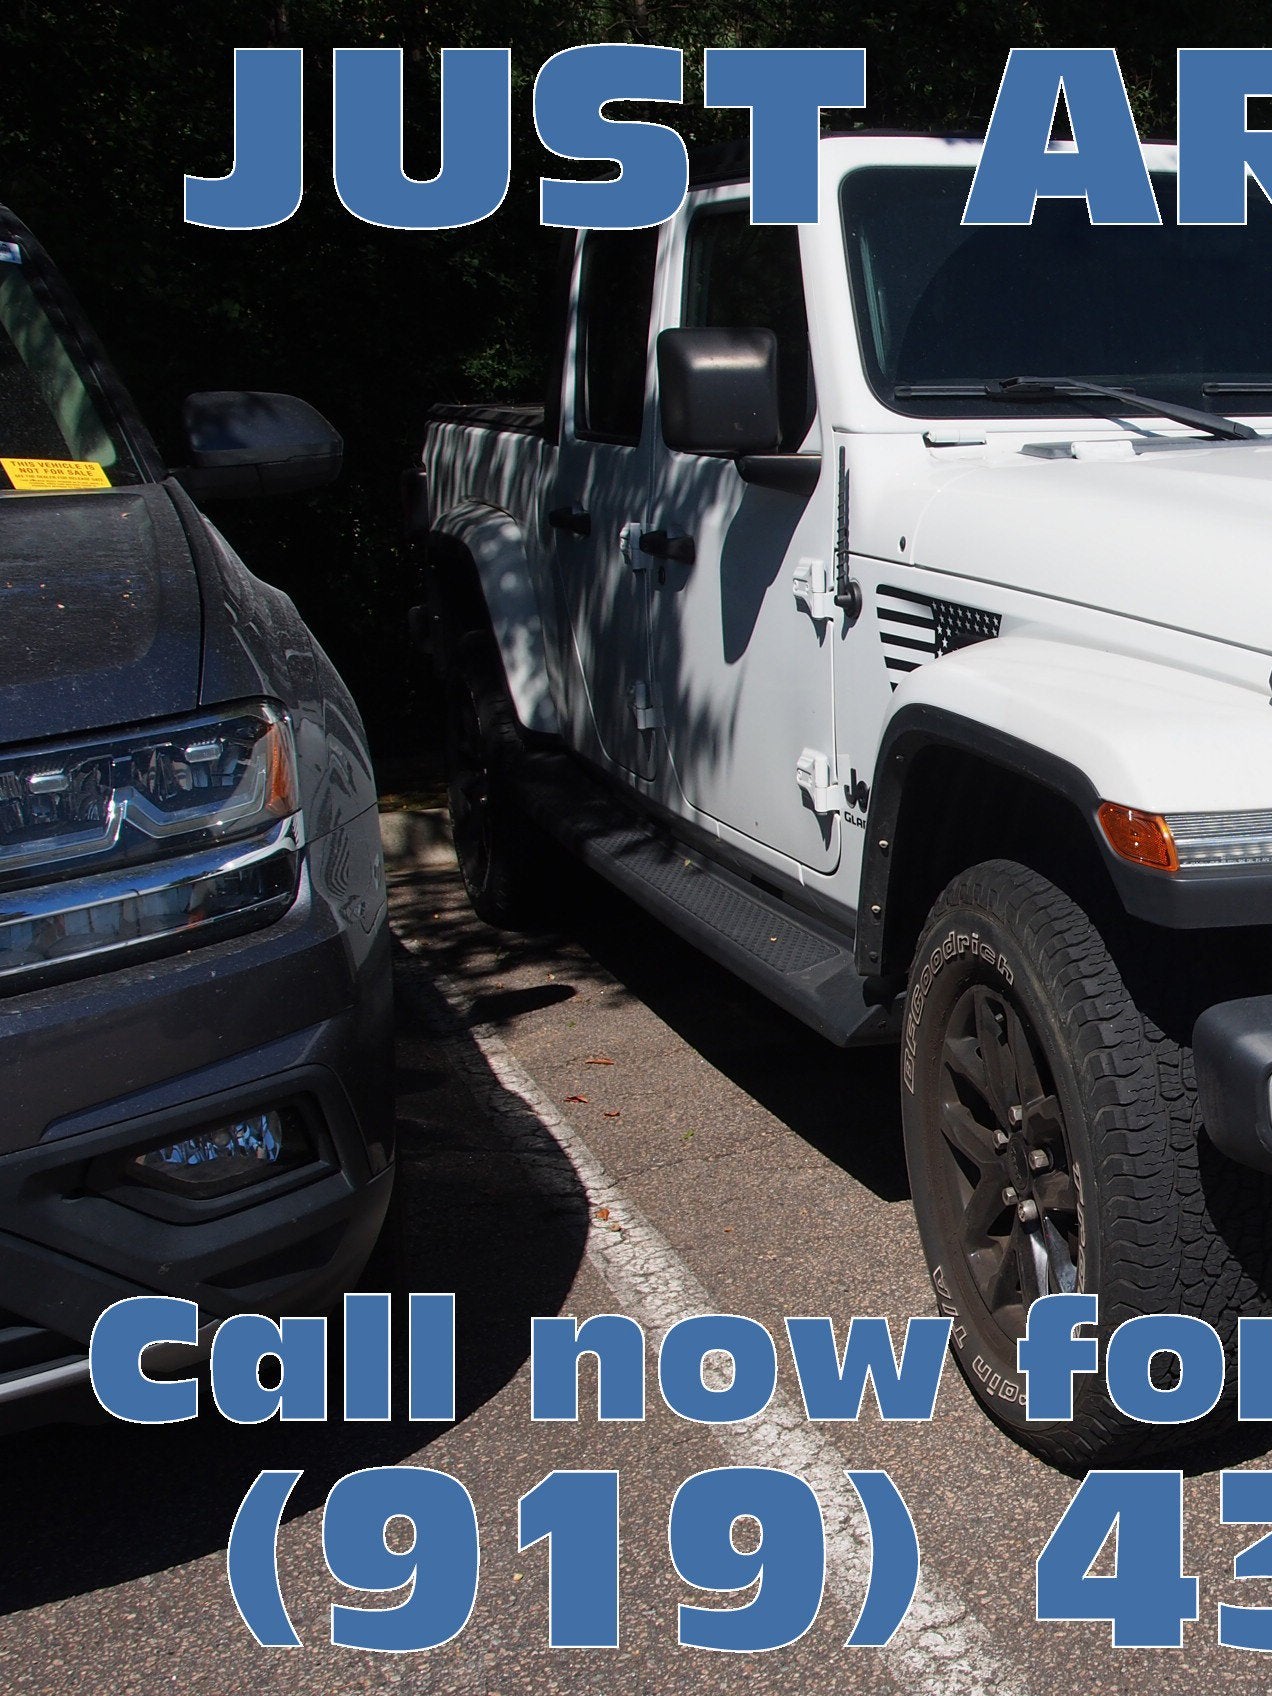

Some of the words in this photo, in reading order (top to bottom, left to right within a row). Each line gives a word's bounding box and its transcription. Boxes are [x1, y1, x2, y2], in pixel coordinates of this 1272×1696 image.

[37, 462, 82, 470] VEHICLE
[44, 468, 64, 476] FOR
[903, 931, 1014, 1096] BFGoodrich
